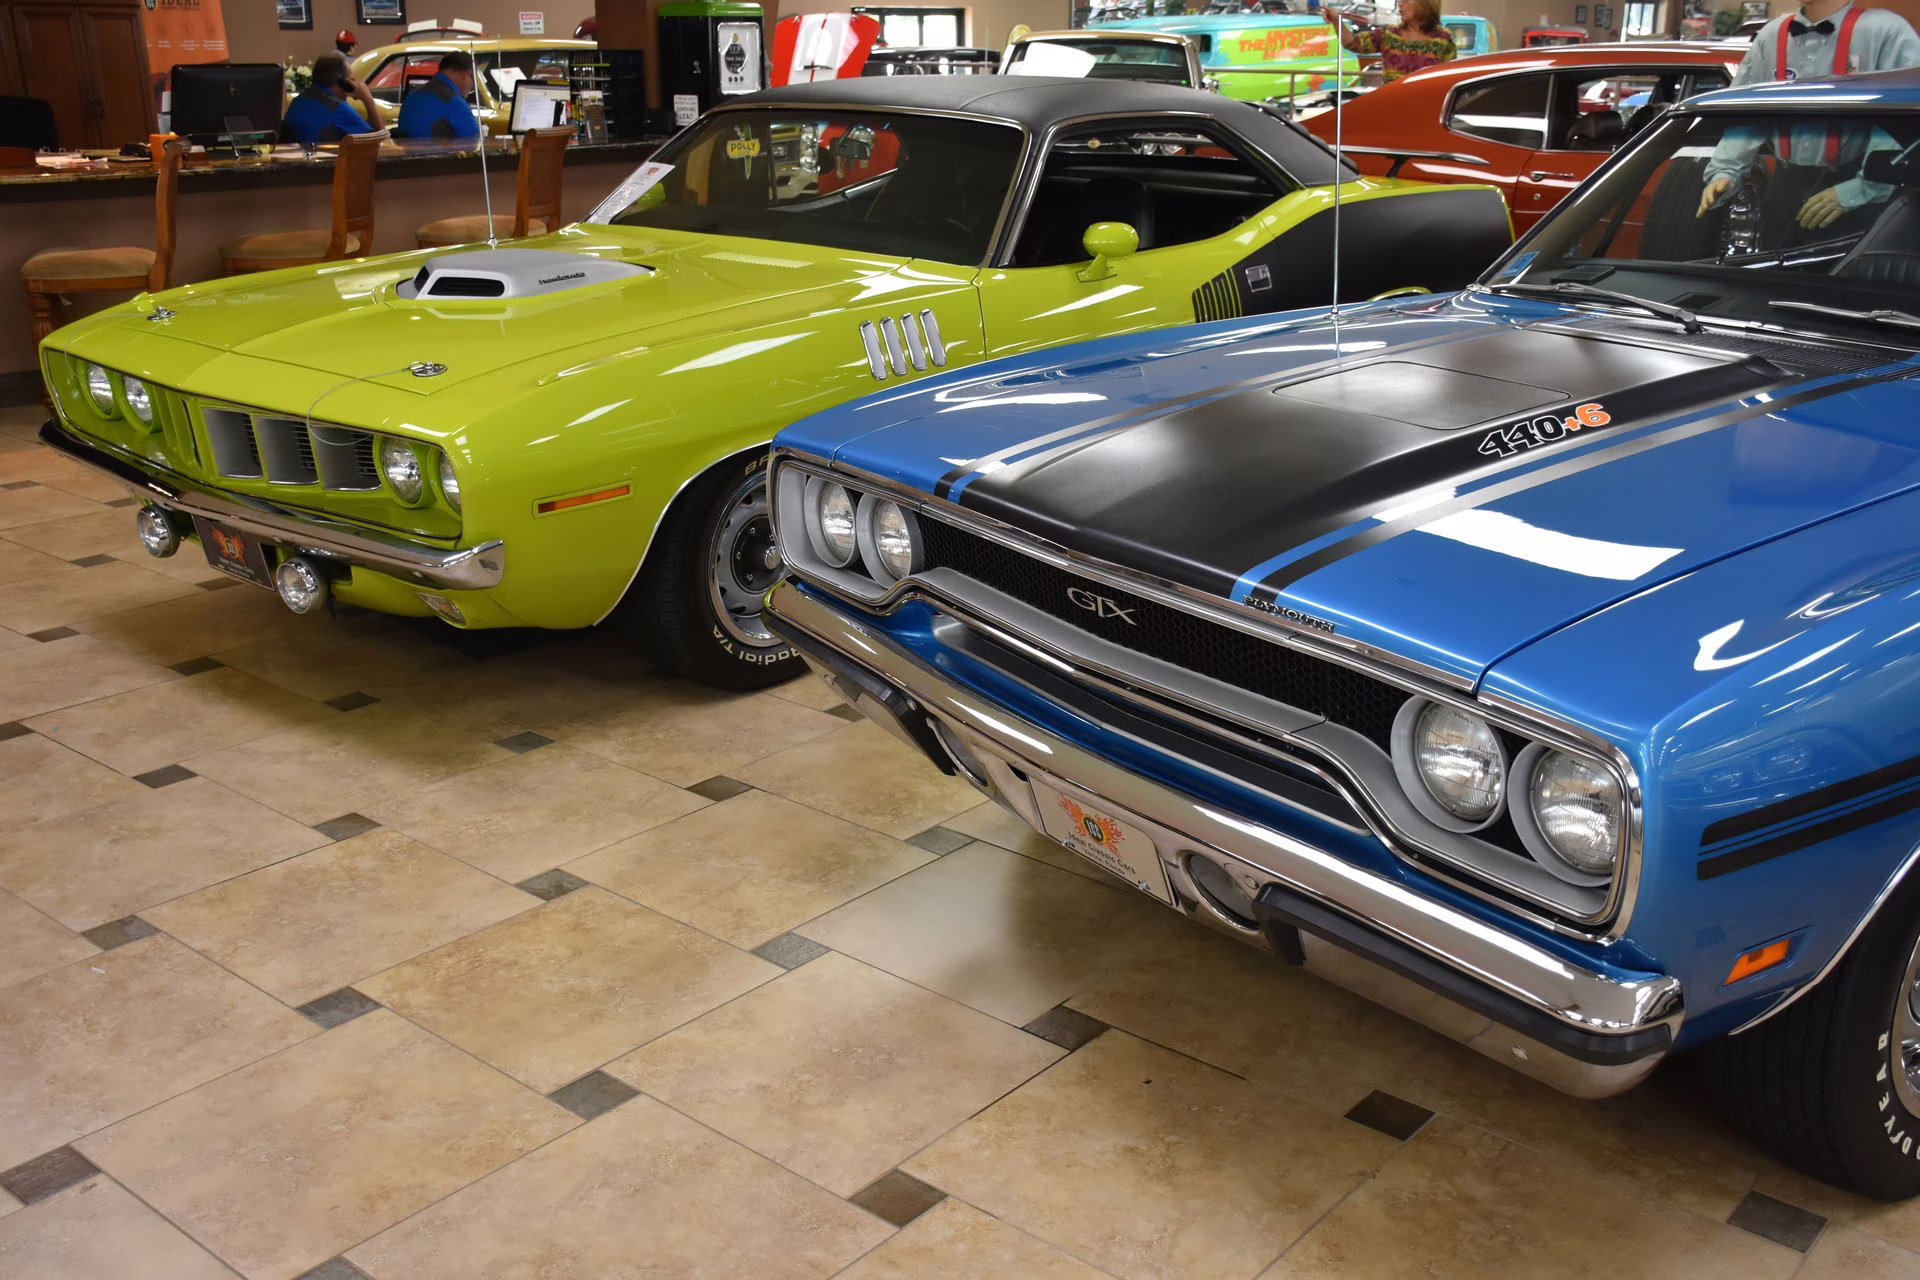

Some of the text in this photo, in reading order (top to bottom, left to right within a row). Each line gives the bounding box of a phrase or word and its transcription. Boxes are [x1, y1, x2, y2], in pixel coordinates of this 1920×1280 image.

[1239, 28, 1331, 52] THE MYSTERY
[730, 142, 756, 152] POLLY
[1066, 587, 1137, 626] GTX
[1243, 594, 1334, 633] PLYMOUTH
[1087, 842, 1116, 863] Classic
[1117, 858, 1136, 875] Cars
